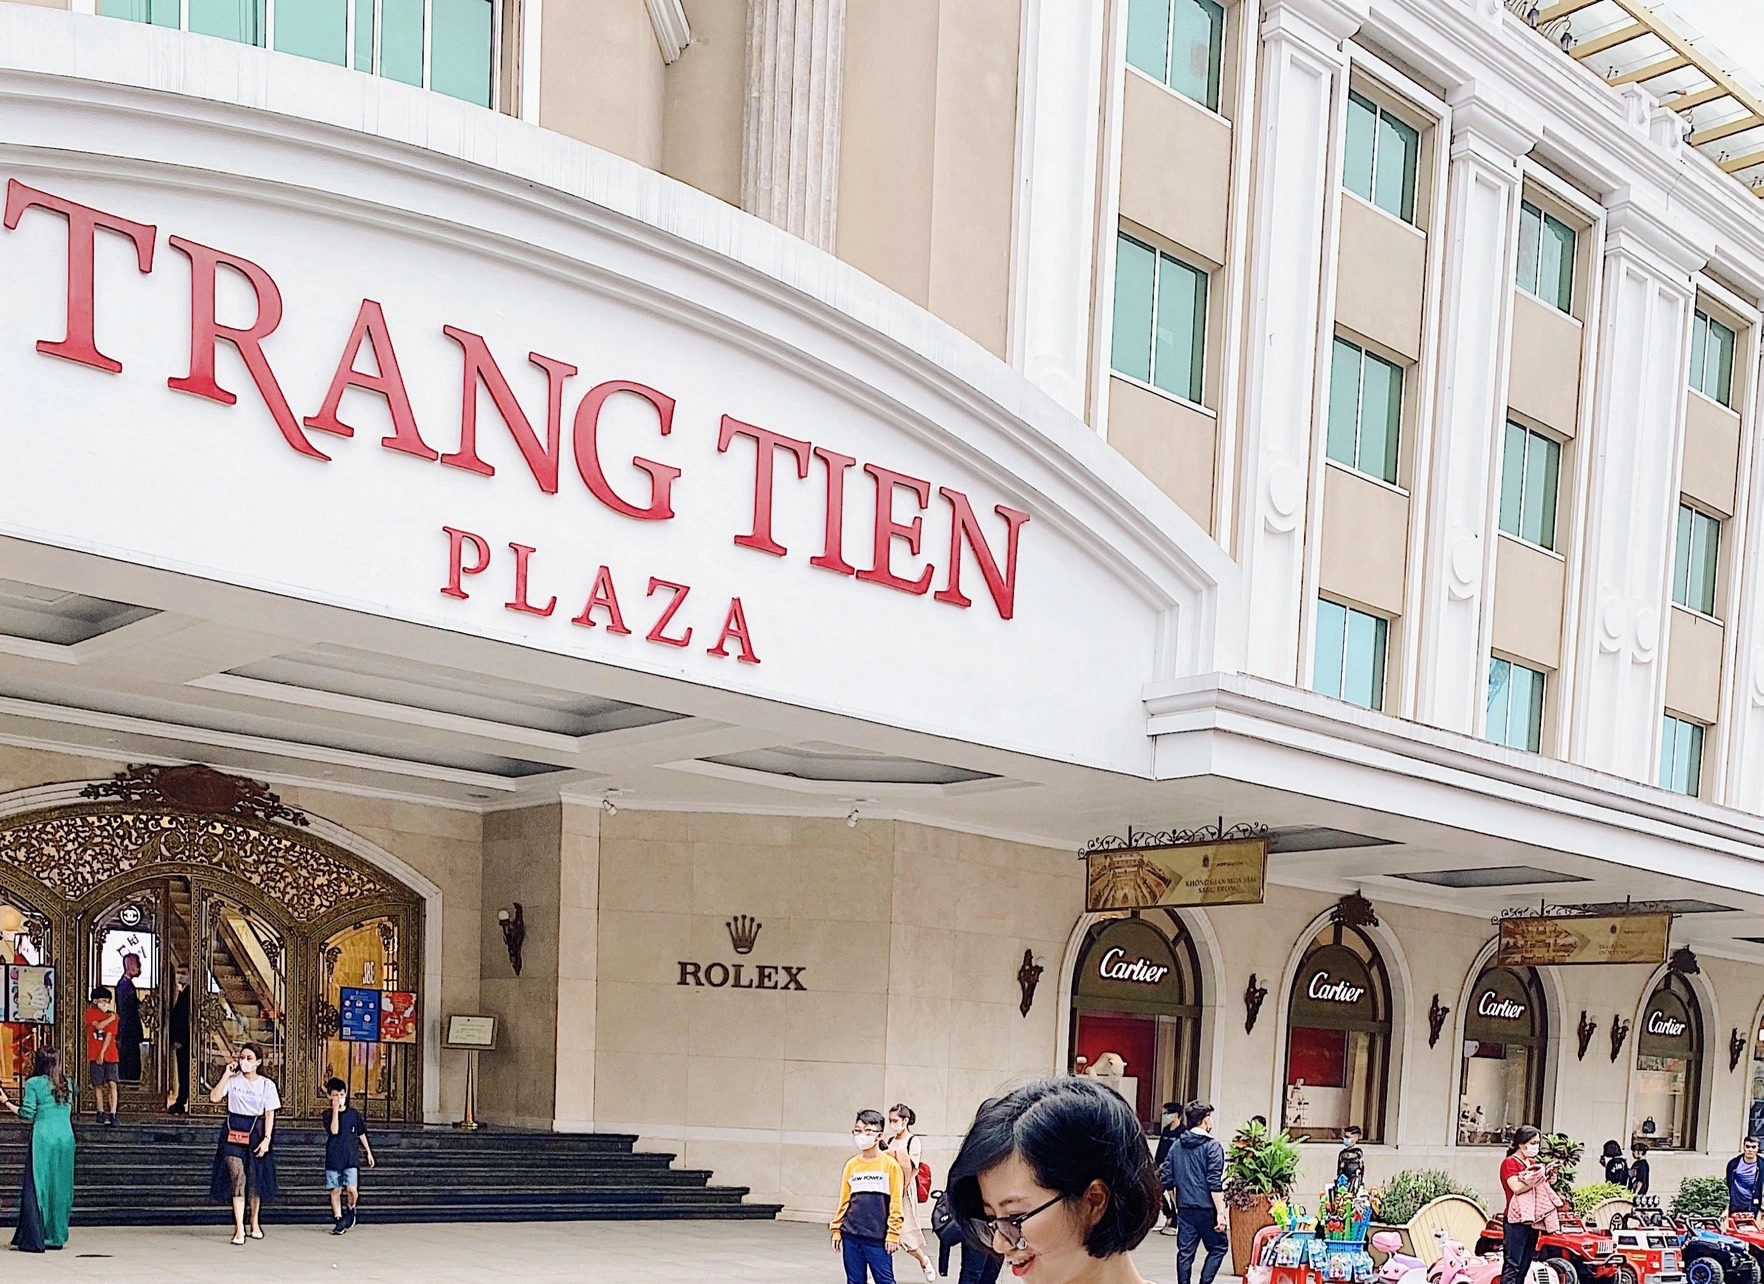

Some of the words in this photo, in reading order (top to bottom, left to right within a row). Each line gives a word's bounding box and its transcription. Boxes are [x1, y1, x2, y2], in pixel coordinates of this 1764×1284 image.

[3, 178, 682, 521] TRANG
[716, 413, 1031, 620] TIEN
[440, 525, 762, 664] PLAZA
[677, 961, 807, 991] ROLEX
[1100, 948, 1168, 983] Cartier
[1308, 971, 1365, 1002] Cartier
[1478, 991, 1525, 1018] Cartier
[1649, 1010, 1686, 1035] Cartier
